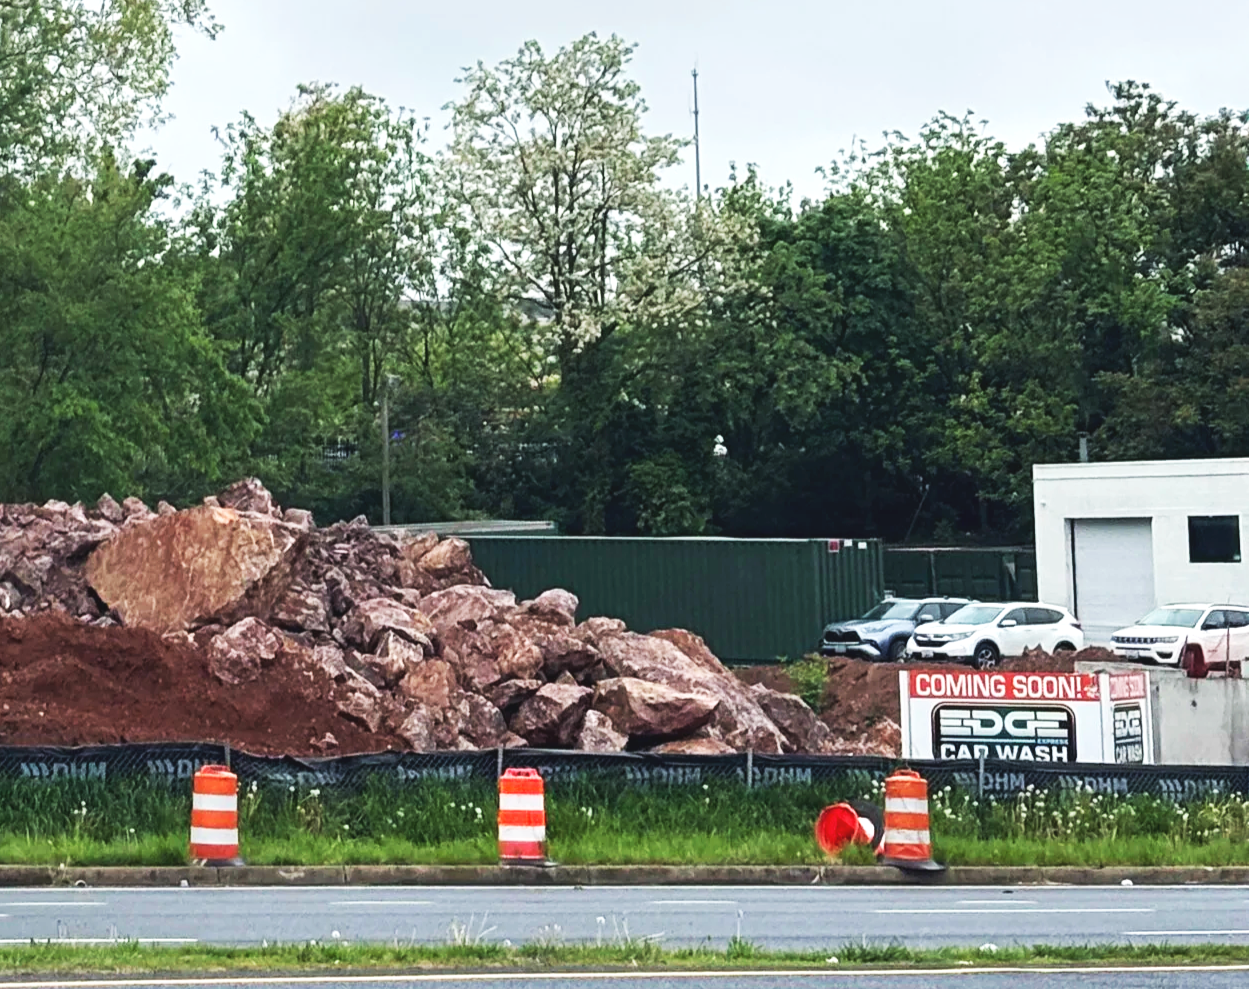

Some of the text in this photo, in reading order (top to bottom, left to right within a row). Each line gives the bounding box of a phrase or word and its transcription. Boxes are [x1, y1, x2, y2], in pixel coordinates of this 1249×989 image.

[915, 673, 1083, 699] COMING SOON!
[940, 709, 1069, 738] EDGE
[994, 743, 1069, 763] WASH
